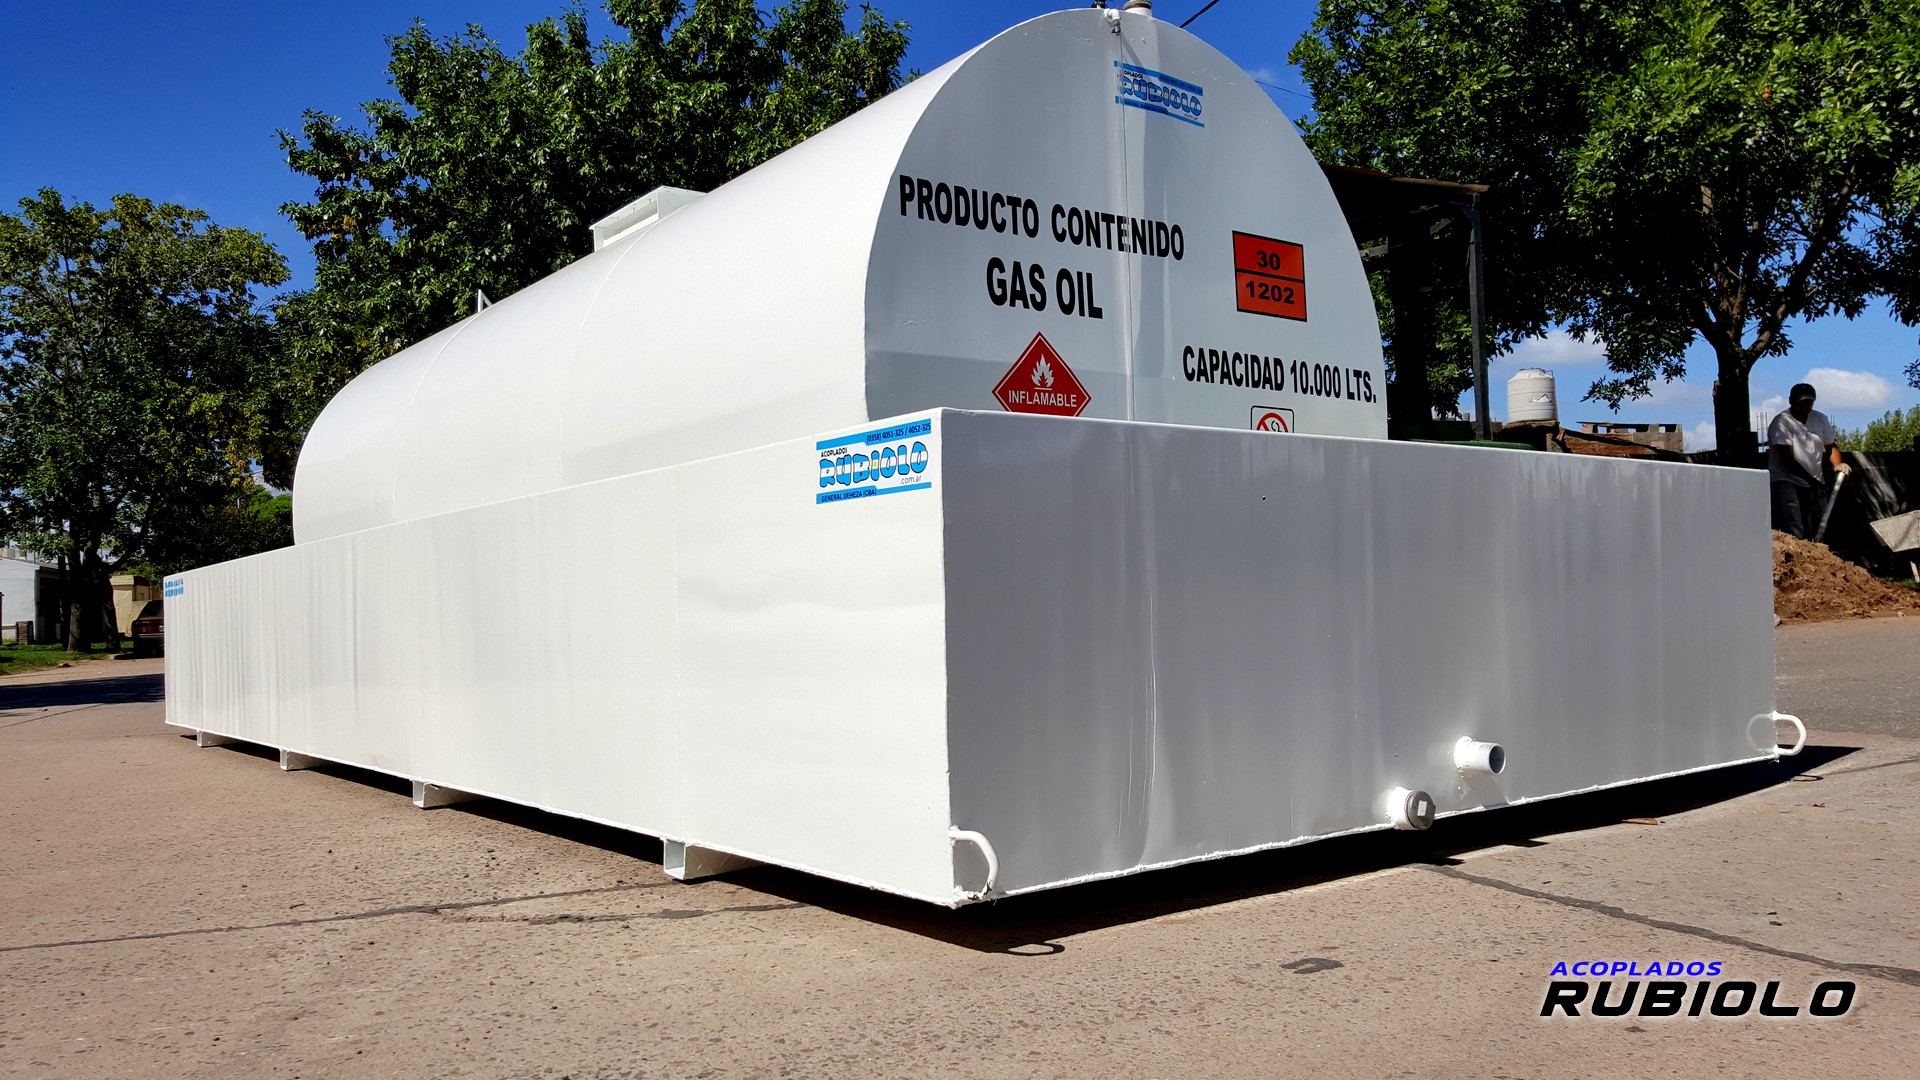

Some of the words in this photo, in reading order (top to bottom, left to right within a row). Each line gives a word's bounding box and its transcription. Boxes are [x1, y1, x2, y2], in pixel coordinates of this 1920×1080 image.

[1118, 75, 1203, 117] RUBIOLO
[900, 174, 1039, 238] PRODUCTO
[1051, 203, 1185, 261] CONTENIDO
[1256, 250, 1281, 271] 30
[986, 256, 1047, 312] GAS
[1055, 267, 1103, 319] OIL
[1245, 280, 1295, 305] 1202
[1182, 345, 1285, 392] CAPACIDAD
[1290, 359, 1341, 399] 10.000
[1345, 367, 1377, 404] LTS.
[1008, 390, 1078, 408] INFLAMABLE
[819, 441, 929, 488] RUBIOLO
[821, 492, 842, 502] GENERAL
[863, 488, 877, 498] (CBA)
